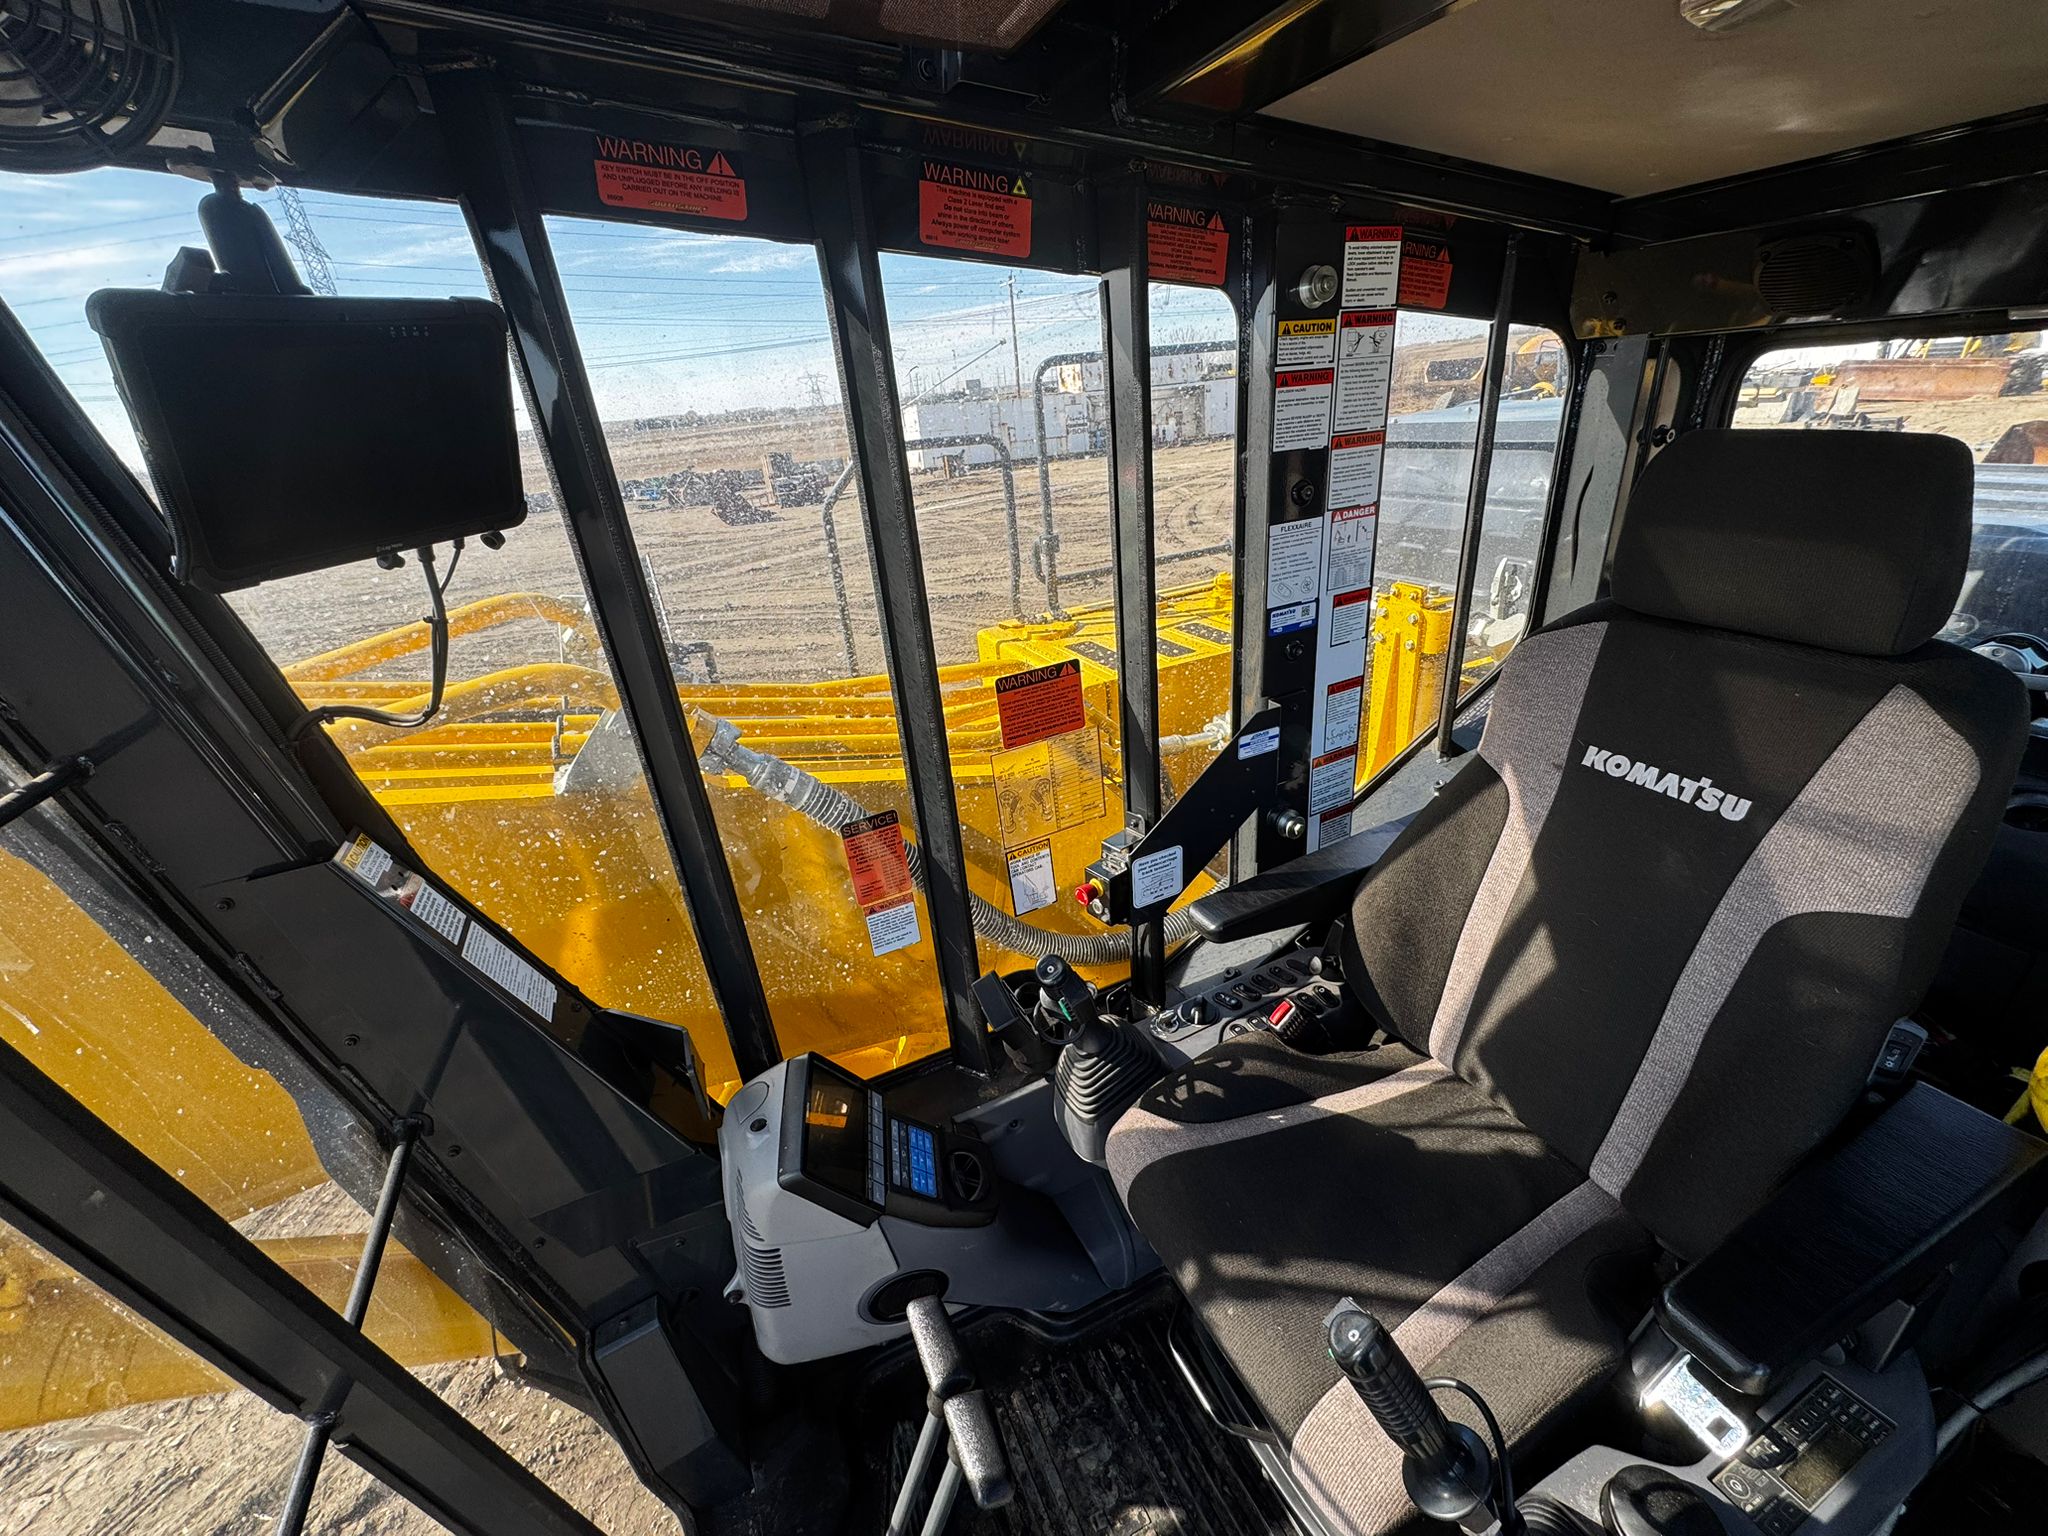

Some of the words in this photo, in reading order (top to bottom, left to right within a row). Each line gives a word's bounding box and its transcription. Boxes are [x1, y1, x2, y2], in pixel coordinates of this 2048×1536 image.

[596, 135, 702, 170] WARNING
[616, 167, 642, 175] SWITCH
[644, 170, 662, 178] MUST
[710, 178, 740, 188] POSITION
[923, 161, 1008, 193] WARNING
[622, 183, 651, 193] CARRIED
[652, 187, 667, 195] OUT
[668, 189, 678, 197] ON
[680, 190, 693, 198] THE
[662, 181, 689, 189] BEFORE
[704, 185, 732, 196] WELDING
[1360, 229, 1399, 239] WARNING
[1355, 313, 1393, 323] WARNING
[1293, 322, 1332, 333] CAUTION
[1291, 372, 1329, 383] WARNING
[1345, 434, 1381, 445] WARNING
[1343, 506, 1375, 519] DANGER
[998, 667, 1057, 691] WARNING
[1581, 745, 1753, 821] KOMATSU
[843, 813, 897, 836] SERVICE!
[1018, 842, 1048, 857] CAUTION
